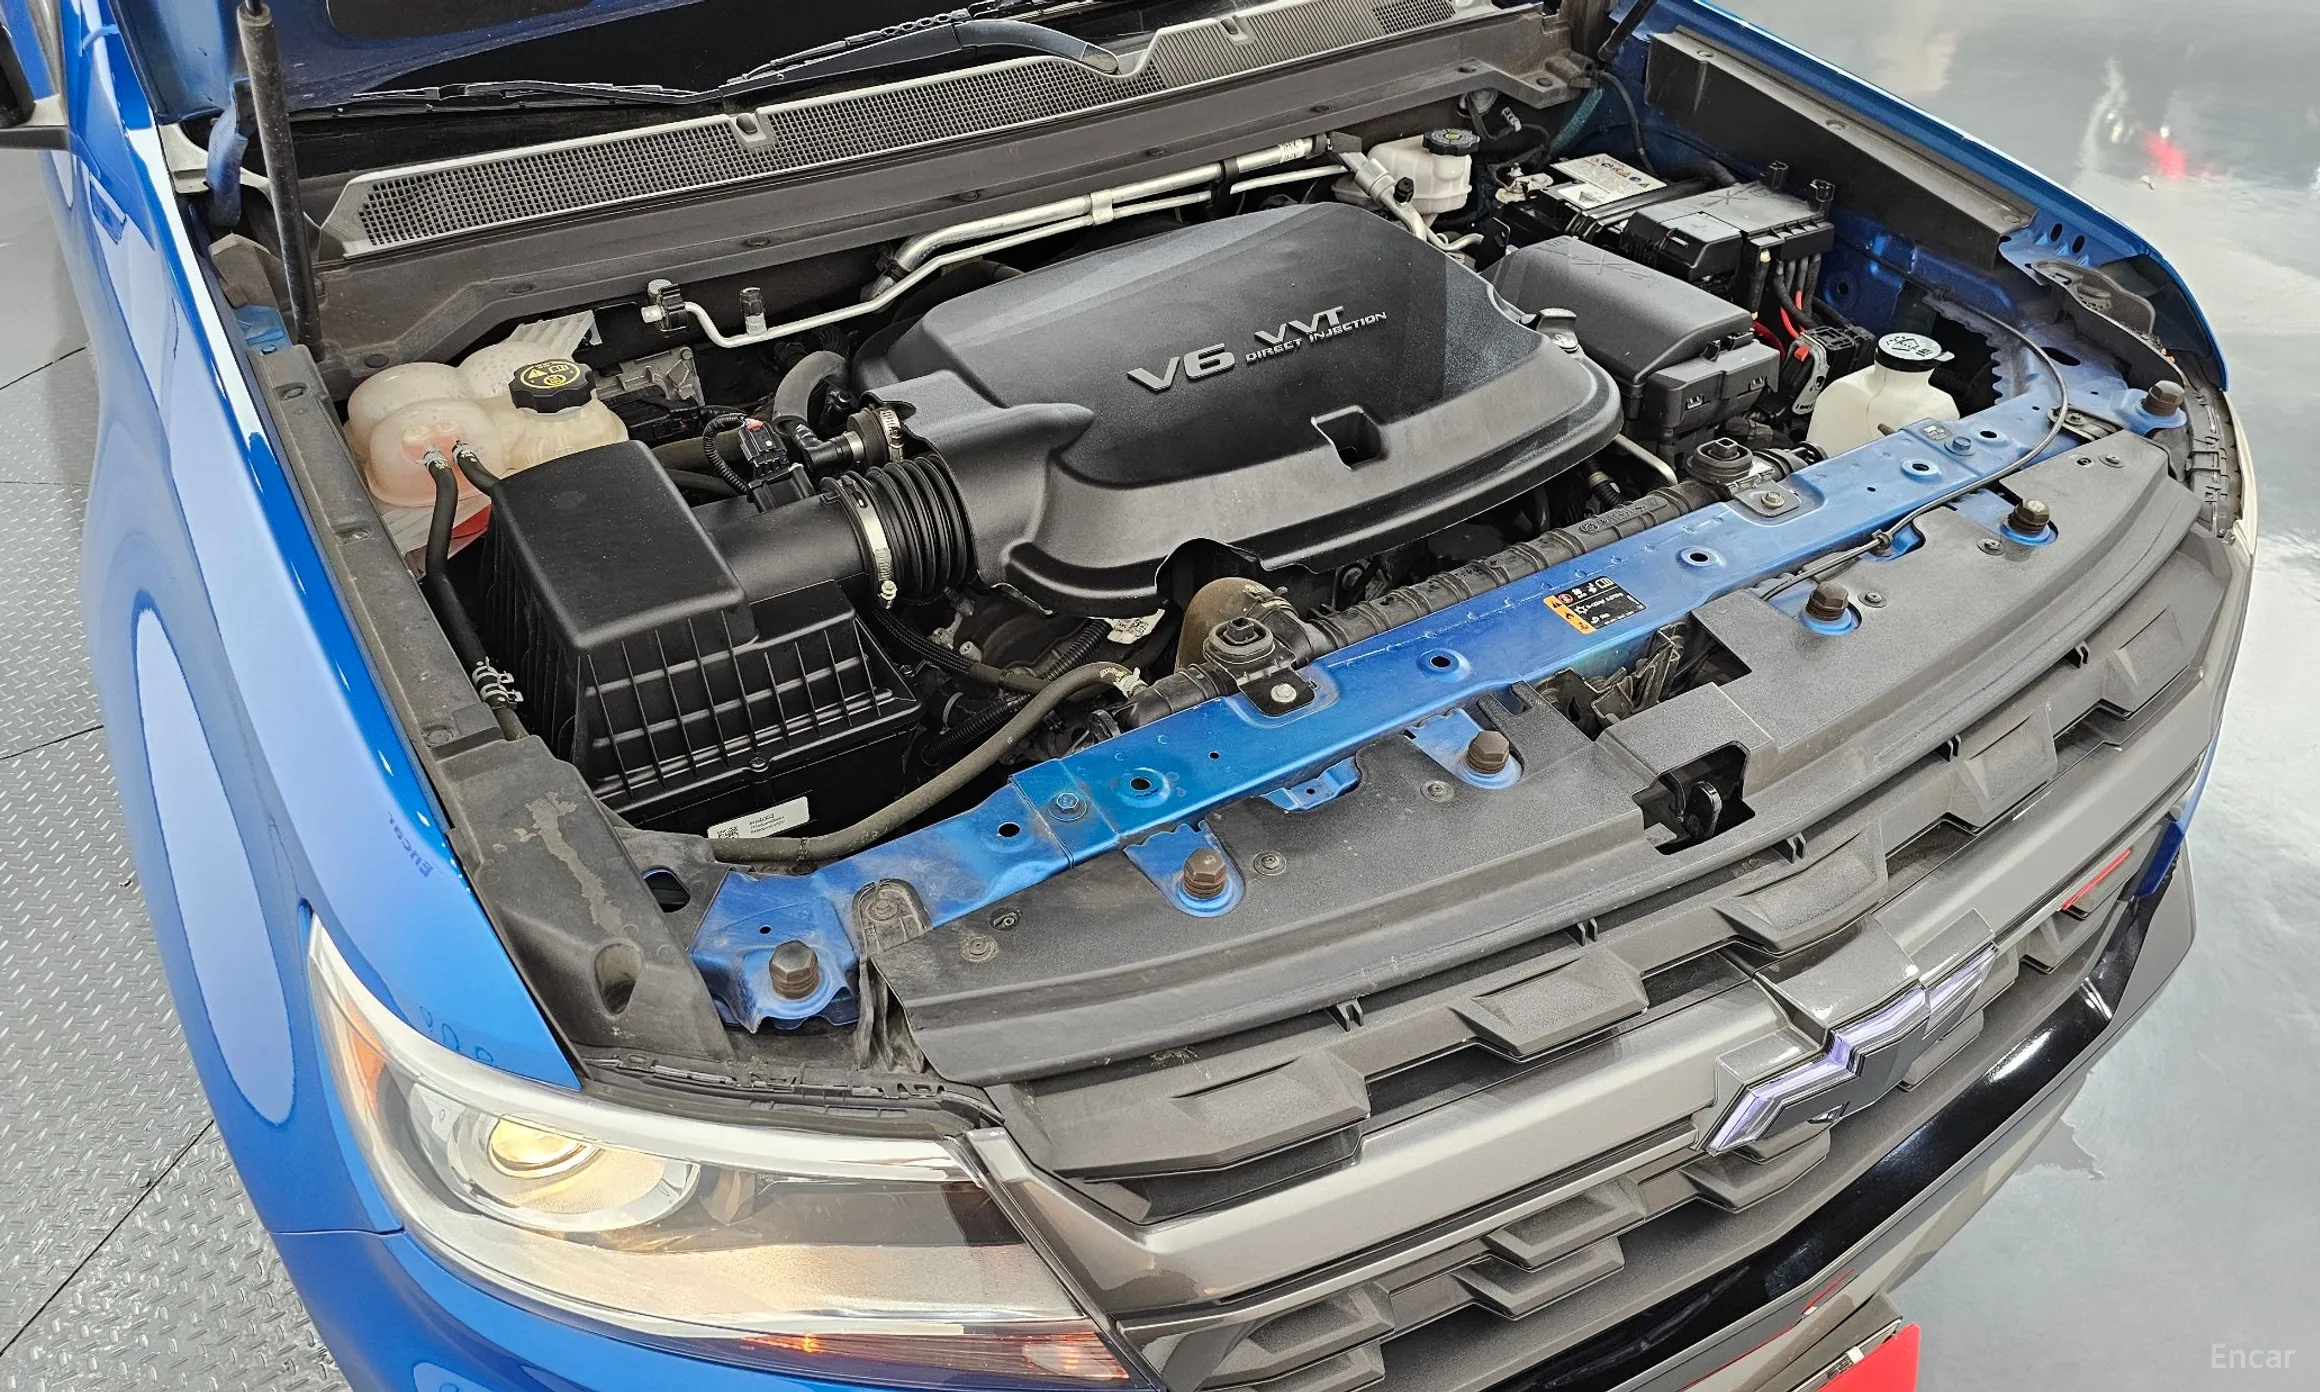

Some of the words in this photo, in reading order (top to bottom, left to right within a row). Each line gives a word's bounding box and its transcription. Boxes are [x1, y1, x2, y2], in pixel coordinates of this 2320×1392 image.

[1245, 338, 1302, 364] DIRECT
[1309, 311, 1387, 343] INJECTION
[1254, 305, 1344, 345] VVT
[1127, 342, 1236, 394] V6
